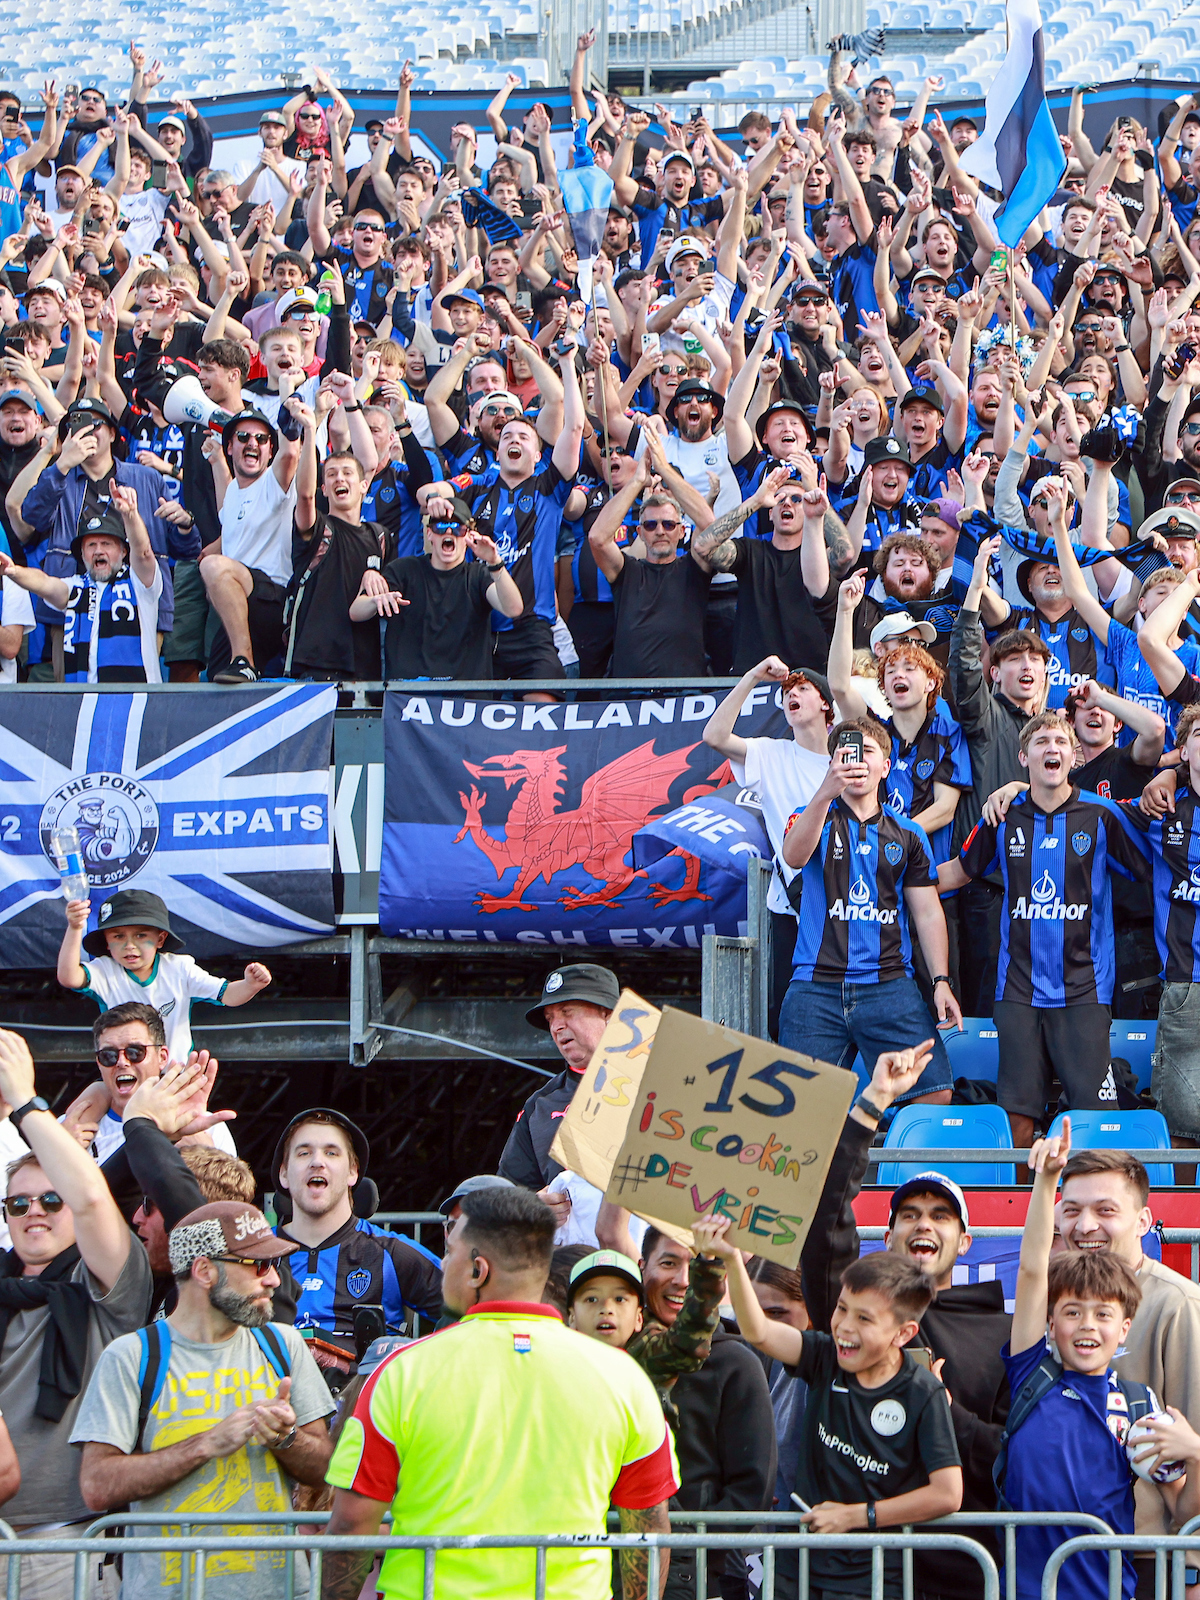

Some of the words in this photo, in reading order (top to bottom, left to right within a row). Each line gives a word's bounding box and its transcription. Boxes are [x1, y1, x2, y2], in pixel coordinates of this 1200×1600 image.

[0, 186, 16, 205] ER
[112, 583, 136, 622] FC
[403, 697, 717, 730] AUCKLAND
[55, 776, 93, 802] THE
[98, 774, 147, 802] PORT
[1097, 781, 1112, 801] G
[0, 815, 21, 842] 2
[173, 804, 324, 837] EXPATS
[663, 806, 747, 844] THE
[103, 866, 132, 885] 2024
[829, 899, 898, 925] Anchor
[1011, 897, 1089, 920] Anchor
